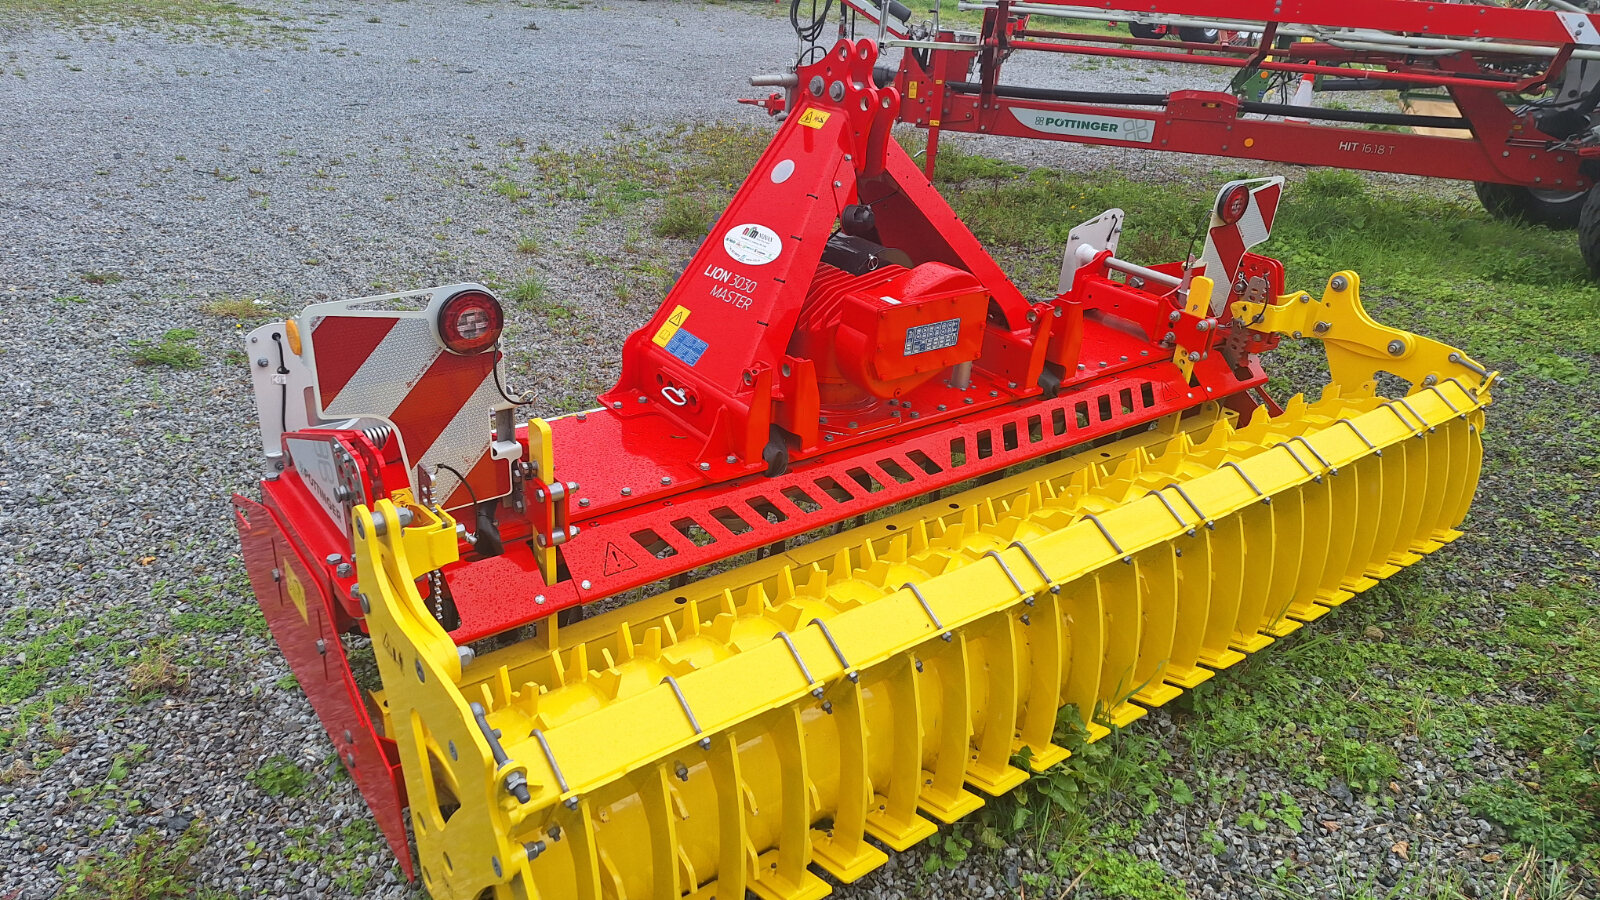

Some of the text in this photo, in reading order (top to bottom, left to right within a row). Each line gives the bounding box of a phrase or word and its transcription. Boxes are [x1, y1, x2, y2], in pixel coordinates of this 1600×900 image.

[1045, 117, 1119, 133] PÖTTINGER
[1338, 141, 1395, 155] HIT 16.18 T
[703, 263, 758, 293] LION 3030
[709, 284, 753, 311] MASTER
